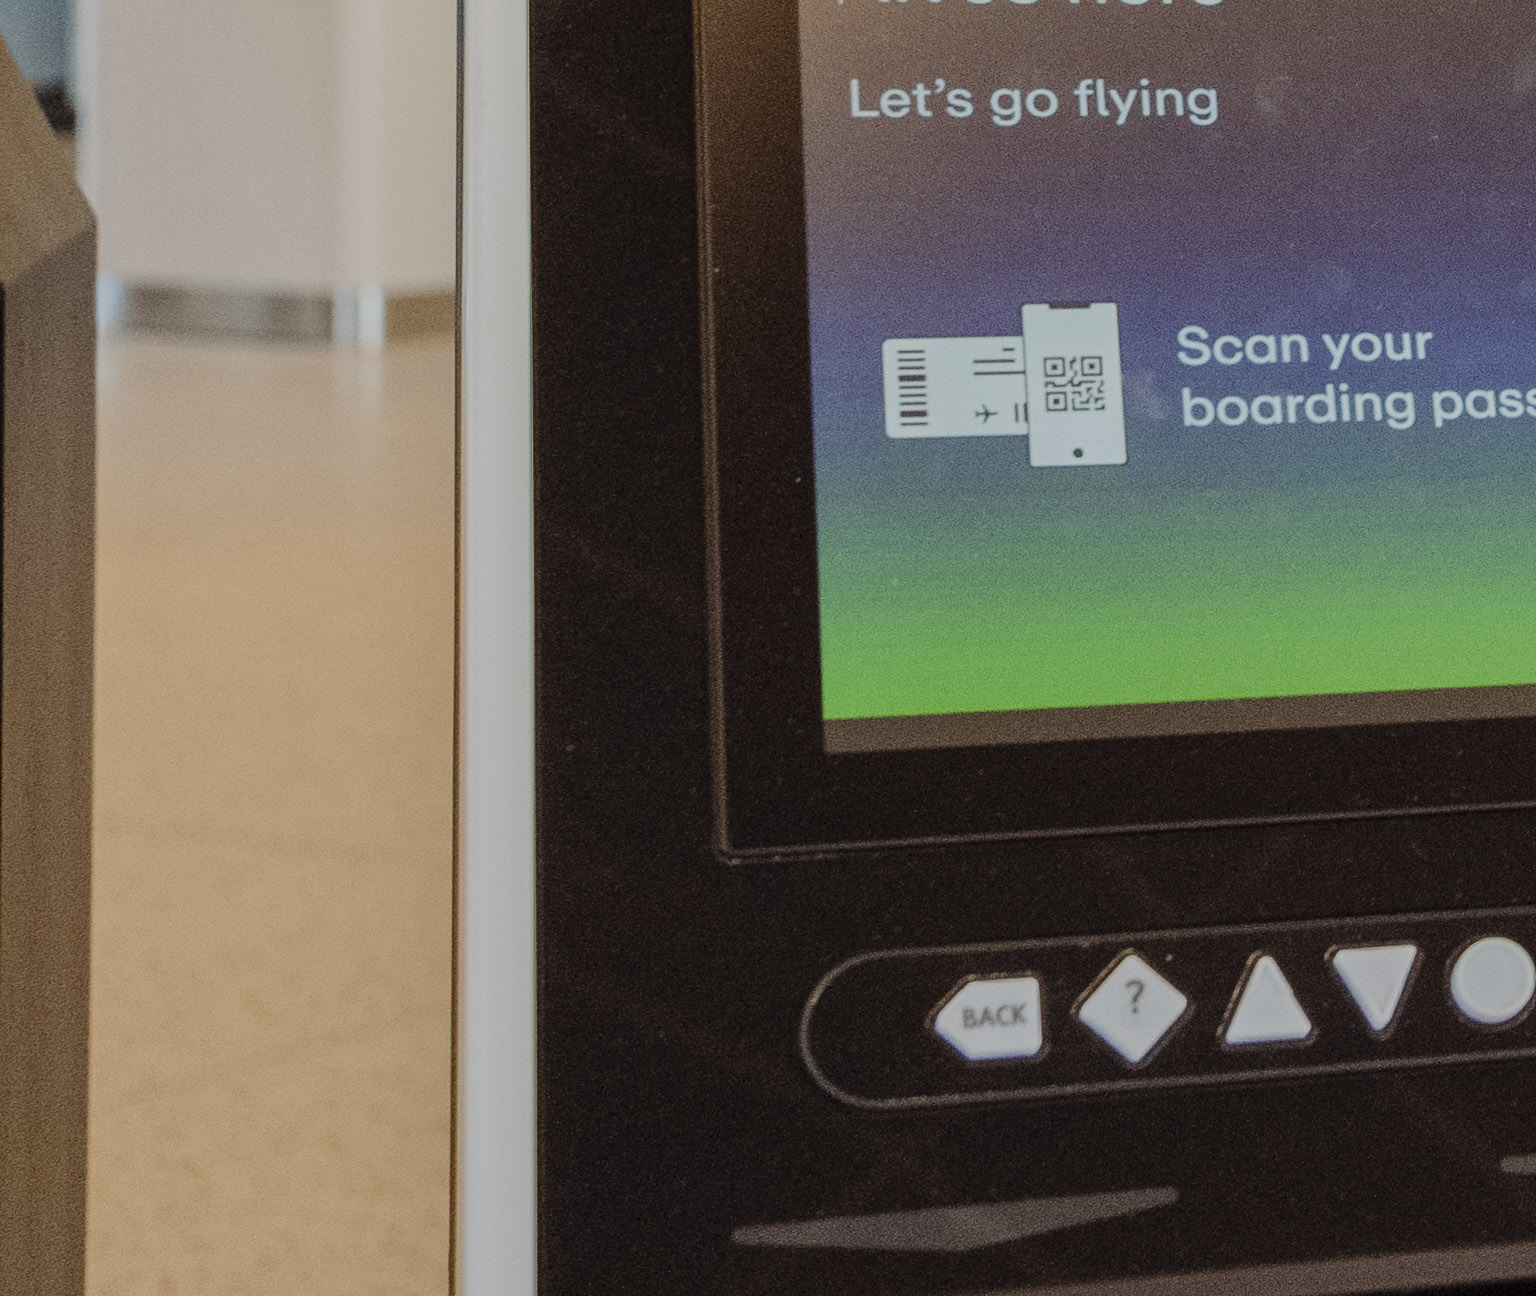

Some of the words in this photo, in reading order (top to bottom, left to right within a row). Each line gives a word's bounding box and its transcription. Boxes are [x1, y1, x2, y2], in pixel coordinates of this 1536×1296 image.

[849, 77, 974, 119] Let's
[990, 88, 1059, 127] go
[1073, 78, 1219, 126] flying
[1177, 325, 1309, 366] Scan
[1322, 331, 1434, 370] your
[1182, 383, 1417, 430] boarding
[962, 1004, 1027, 1029] BACK
[1125, 979, 1145, 1015] ?
